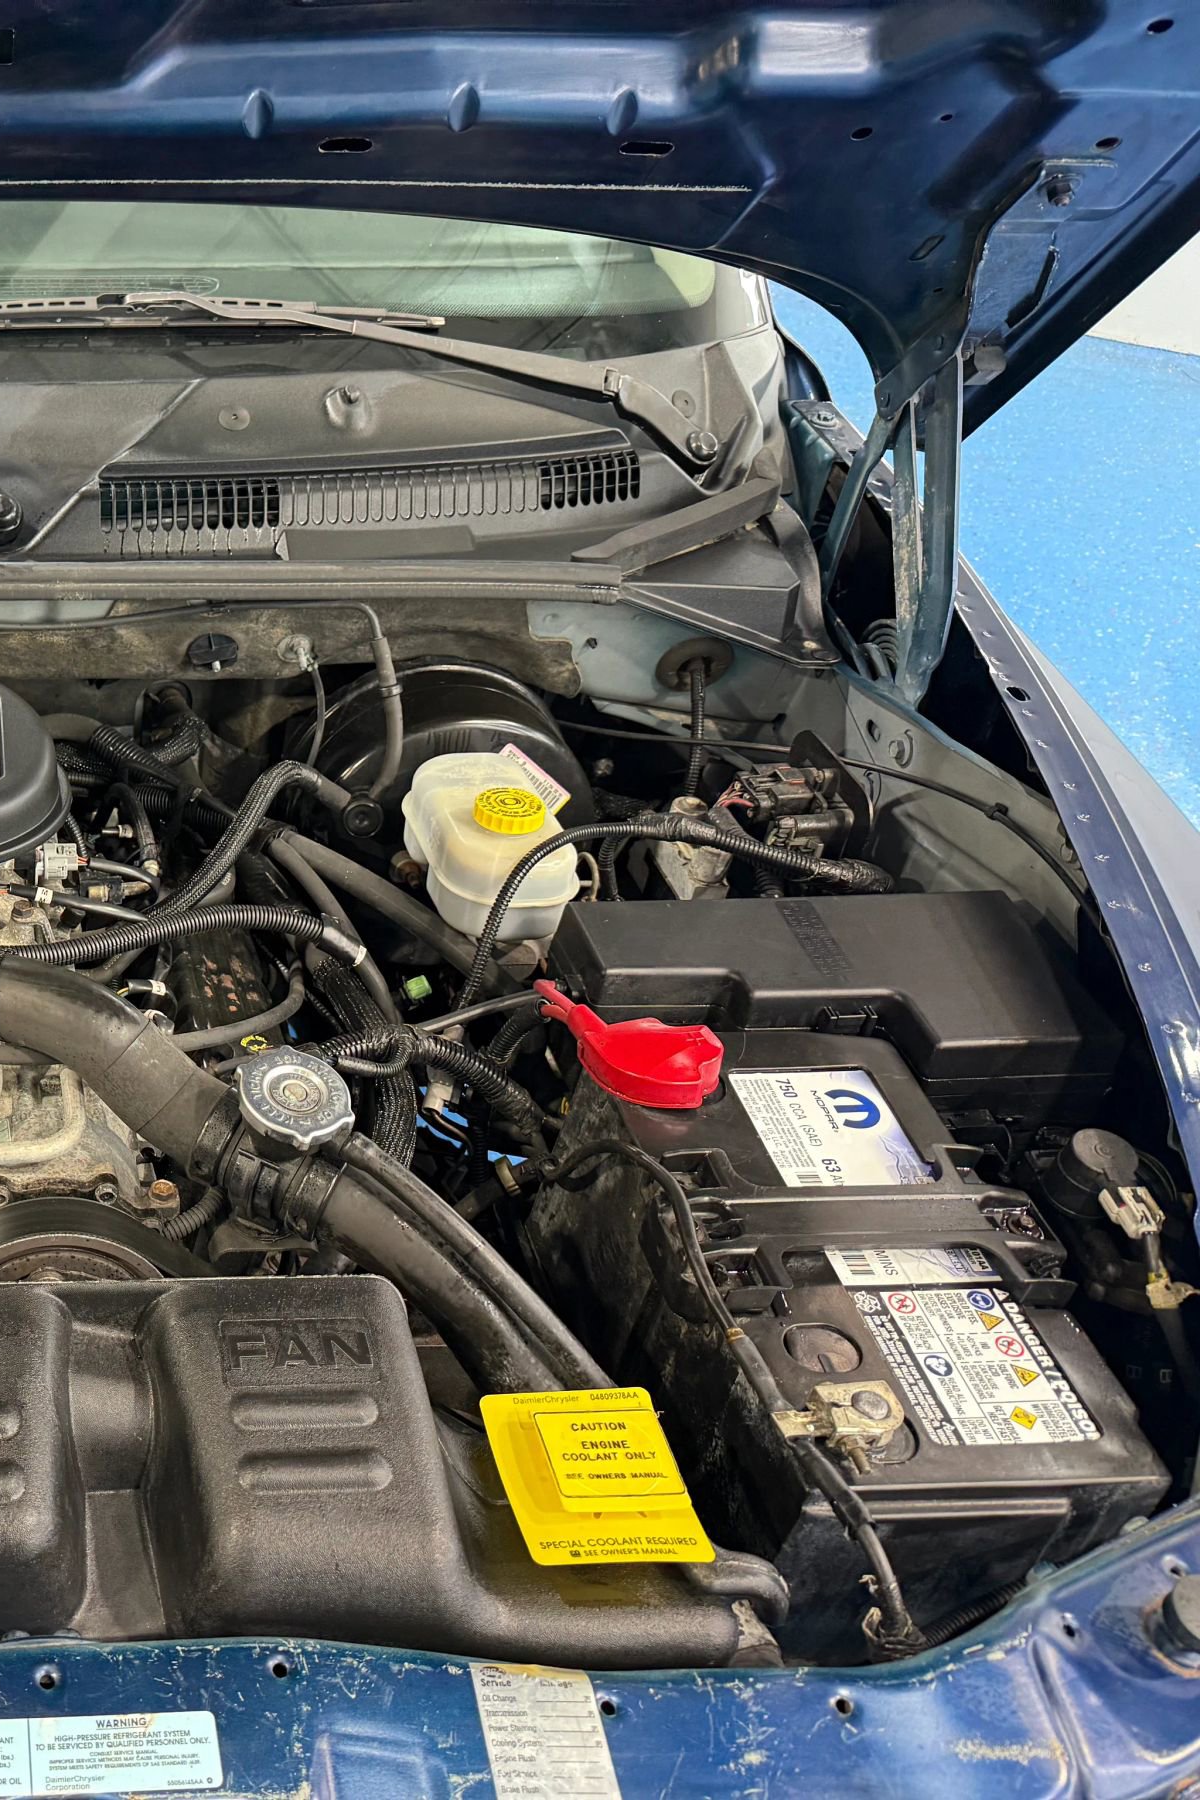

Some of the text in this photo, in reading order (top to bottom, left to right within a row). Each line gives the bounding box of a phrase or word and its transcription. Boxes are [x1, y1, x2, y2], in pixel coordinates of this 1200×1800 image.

[809, 1090, 840, 1129] MOPAR
[774, 1079, 843, 1172] 750 CCA (SAE) 63
[872, 1250, 900, 1276] MINS
[1002, 1302, 1055, 1368] DANGER
[228, 1329, 374, 1369] FAN
[986, 1365, 1001, 1377] ACID
[995, 1364, 1020, 1389] SULFURIC
[513, 1392, 639, 1405] DaimlerChrysler 04809378AA
[571, 1422, 627, 1432] CAUTION
[581, 1440, 630, 1450] ENGINE
[562, 1451, 657, 1462] COOLANT ONLY
[539, 1537, 698, 1550] SPECIAL COOLANT REQUIRED
[583, 1549, 599, 1557] SEE
[642, 1547, 678, 1555] MANUAL
[480, 1678, 513, 1688] Service
[491, 1694, 518, 1703] Change
[485, 1709, 529, 1718] Transmission
[96, 1718, 147, 1728] WARNING
[54, 1730, 191, 1743] HIGH-PRESSURE REFRIGERANT SYSTEM
[58, 1742, 93, 1750] SERVICED
[107, 1740, 144, 1748] QUALIFIED
[146, 1738, 188, 1746] PERSONNEL
[491, 1739, 517, 1748] Cooling
[45, 1774, 105, 1784] DaimlerChrysler
[46, 1783, 91, 1792] Corporation
